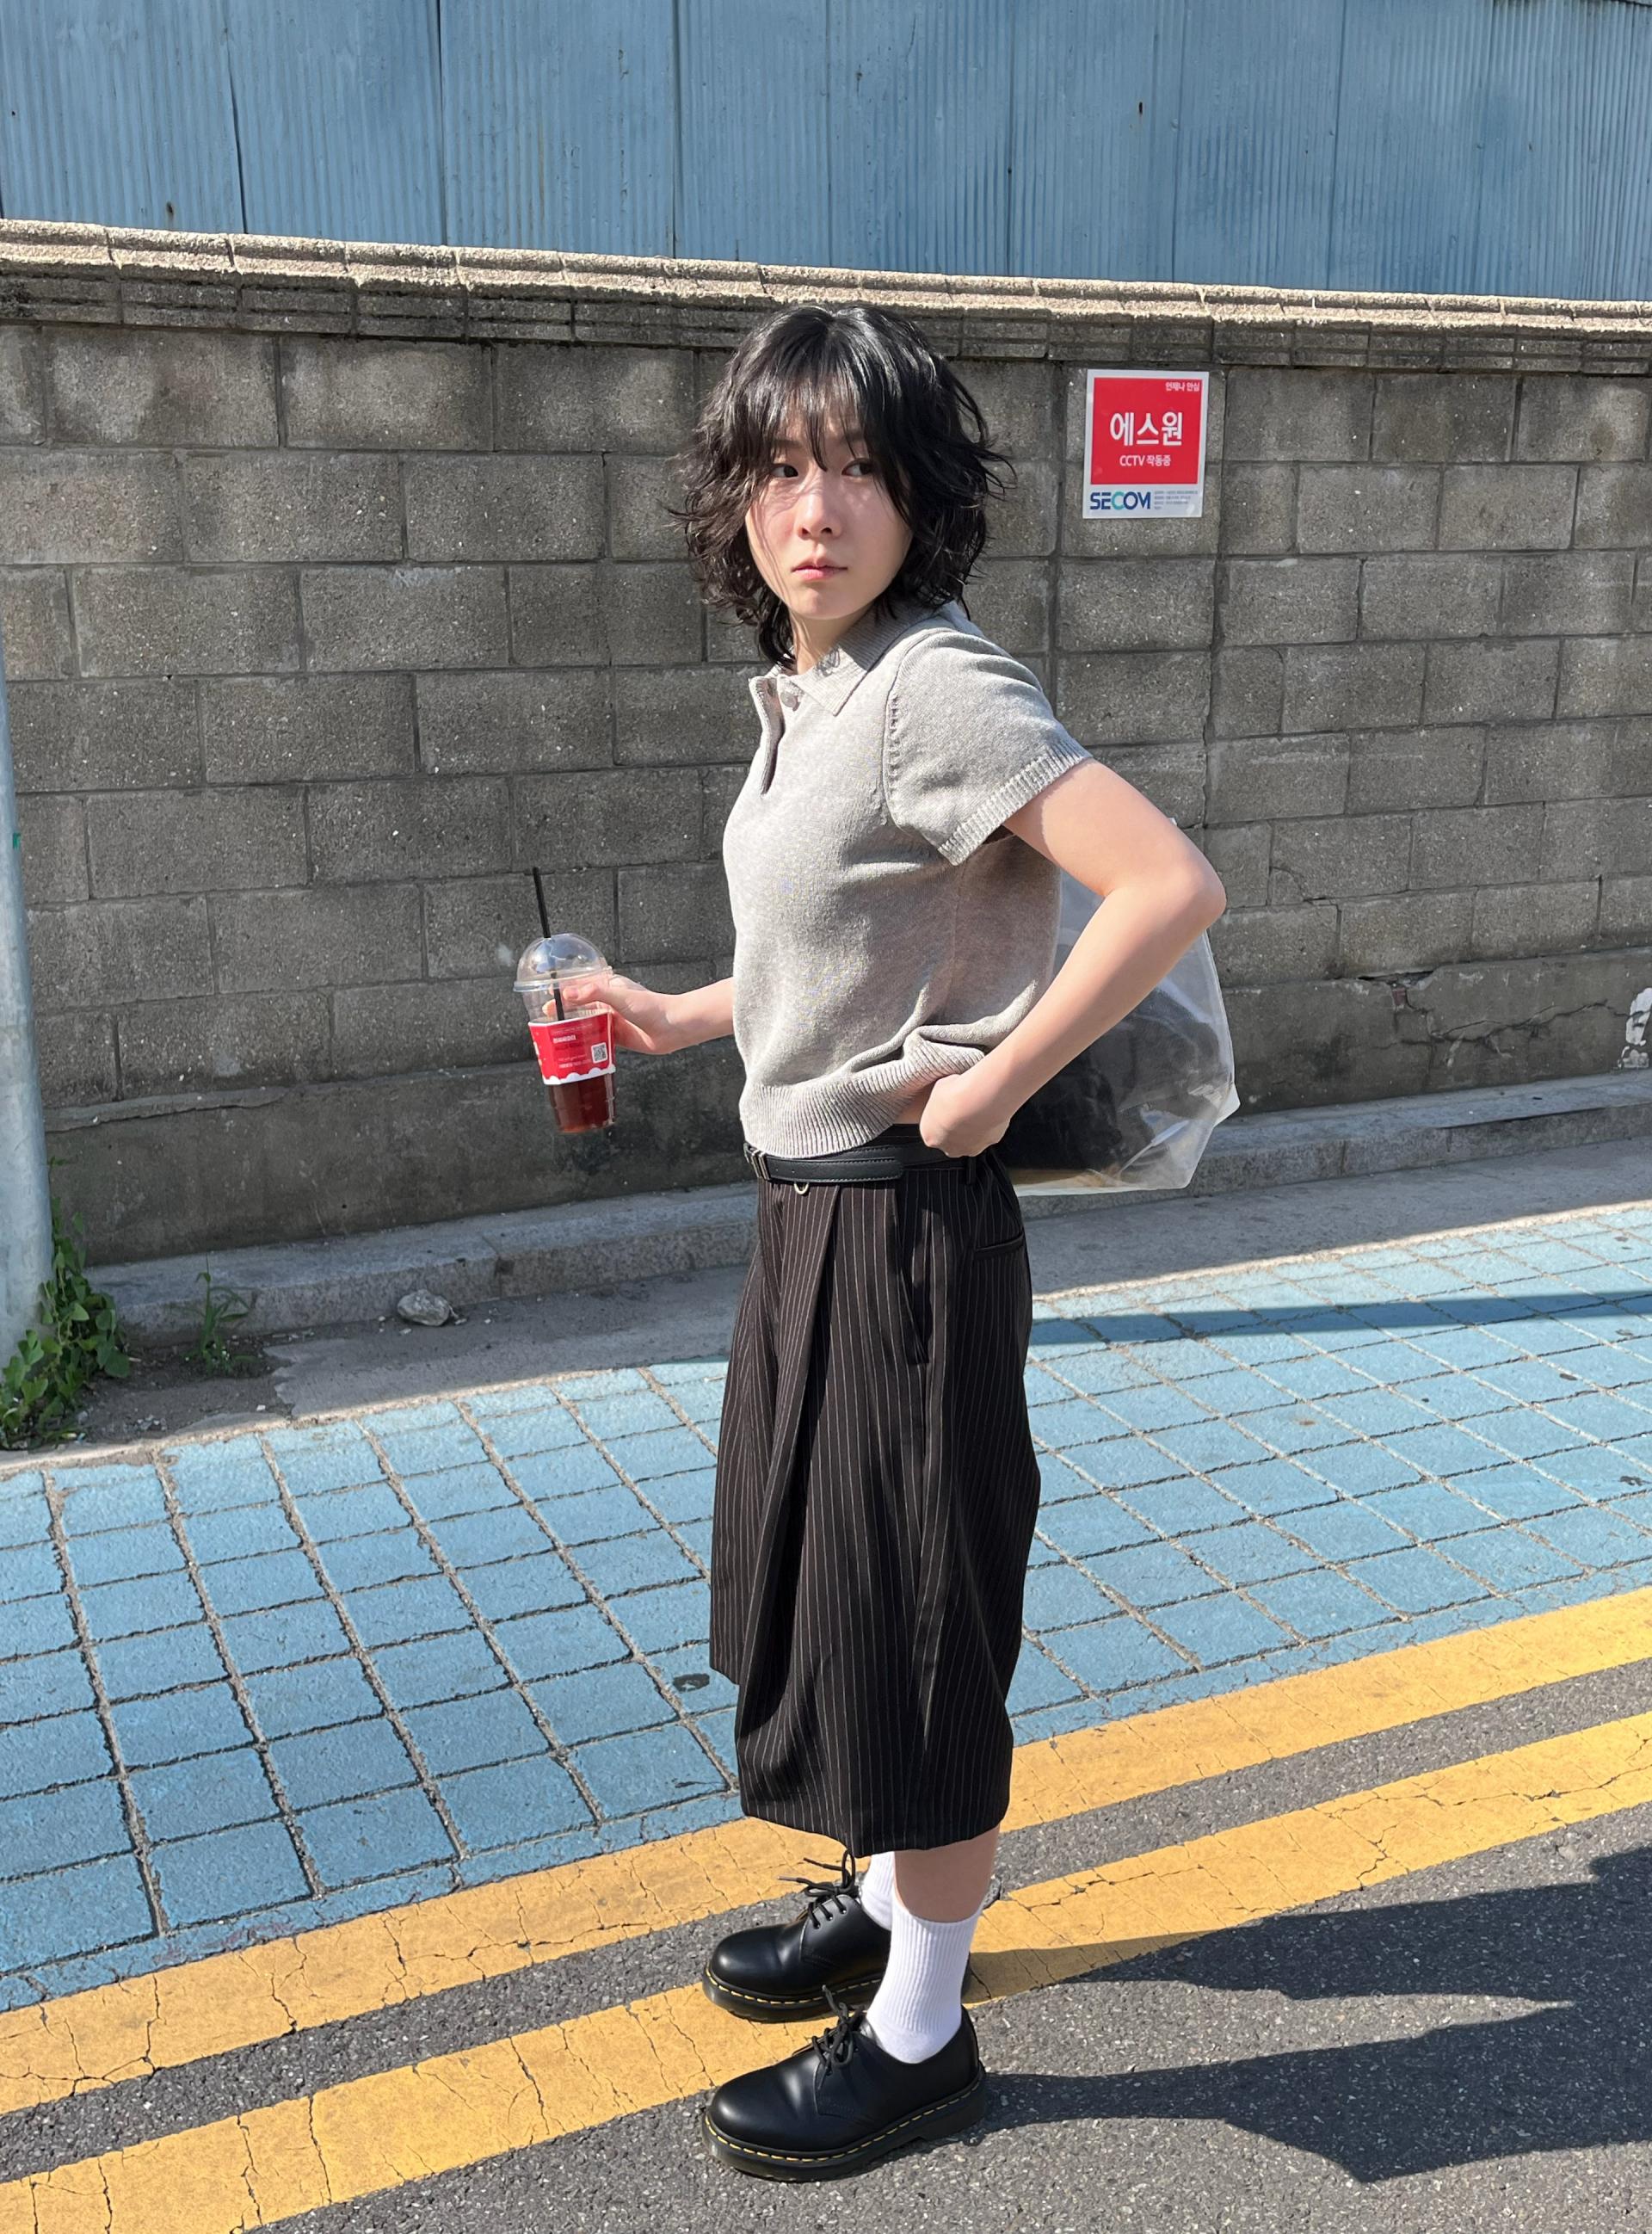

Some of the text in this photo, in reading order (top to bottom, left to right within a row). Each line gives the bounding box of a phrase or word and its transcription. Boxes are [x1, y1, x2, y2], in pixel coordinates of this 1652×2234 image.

[1110, 411, 1183, 447] 에스원
[1119, 454, 1171, 466] CCTV 작동중
[1090, 491, 1151, 510] SECOM
